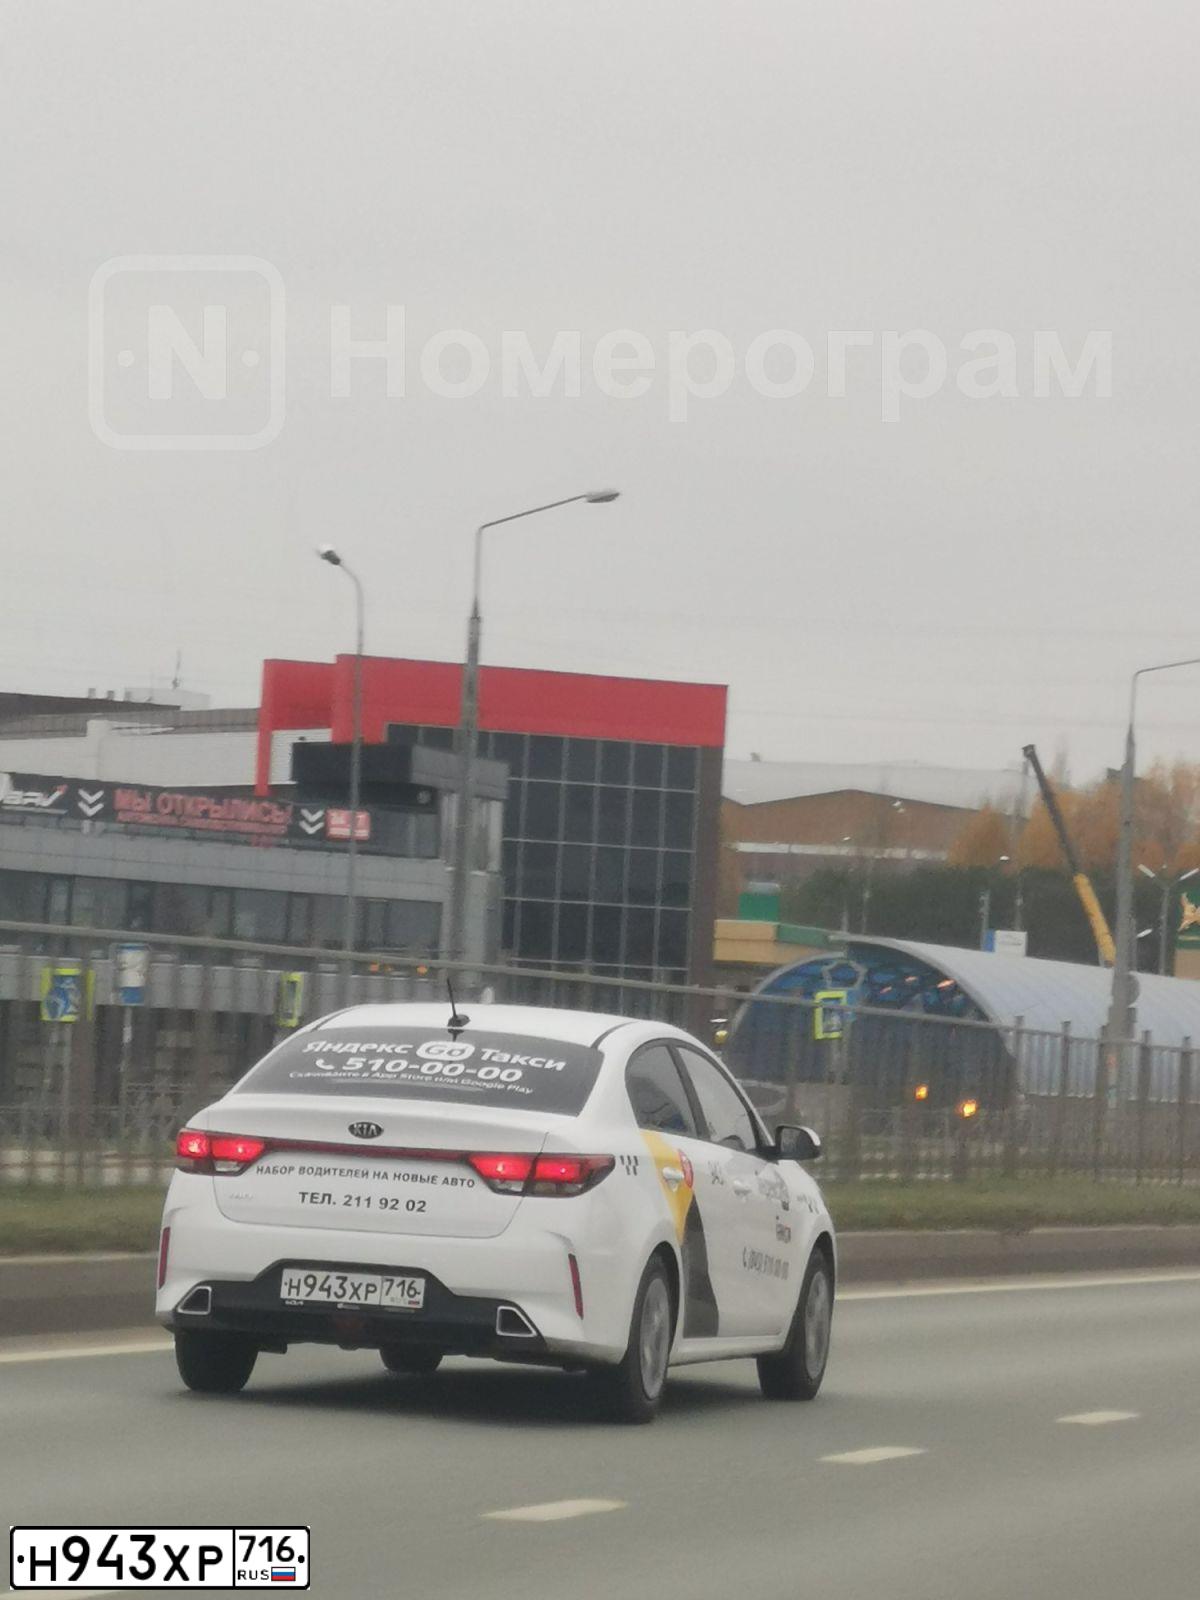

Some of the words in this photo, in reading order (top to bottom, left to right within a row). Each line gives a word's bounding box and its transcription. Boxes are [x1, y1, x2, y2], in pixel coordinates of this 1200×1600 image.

[302, 1040, 413, 1054] Яндекс
[481, 1048, 566, 1071] Такси
[342, 1056, 523, 1082] 510-00-00
[353, 1123, 379, 1137] KIA
[256, 1165, 295, 1175] НАБОР
[298, 1166, 369, 1179] ВОДИТЕЛЕЙ
[372, 1170, 390, 1180] НА
[393, 1172, 438, 1185] НОВЫЕ
[441, 1177, 476, 1188] АВТО
[299, 1191, 337, 1205] ТЕЛ.
[343, 1195, 373, 1208] 211
[379, 1198, 399, 1211] 92
[405, 1199, 427, 1213] 02
[288, 1274, 378, 1301] Н943ХР
[385, 1278, 417, 1298] 716
